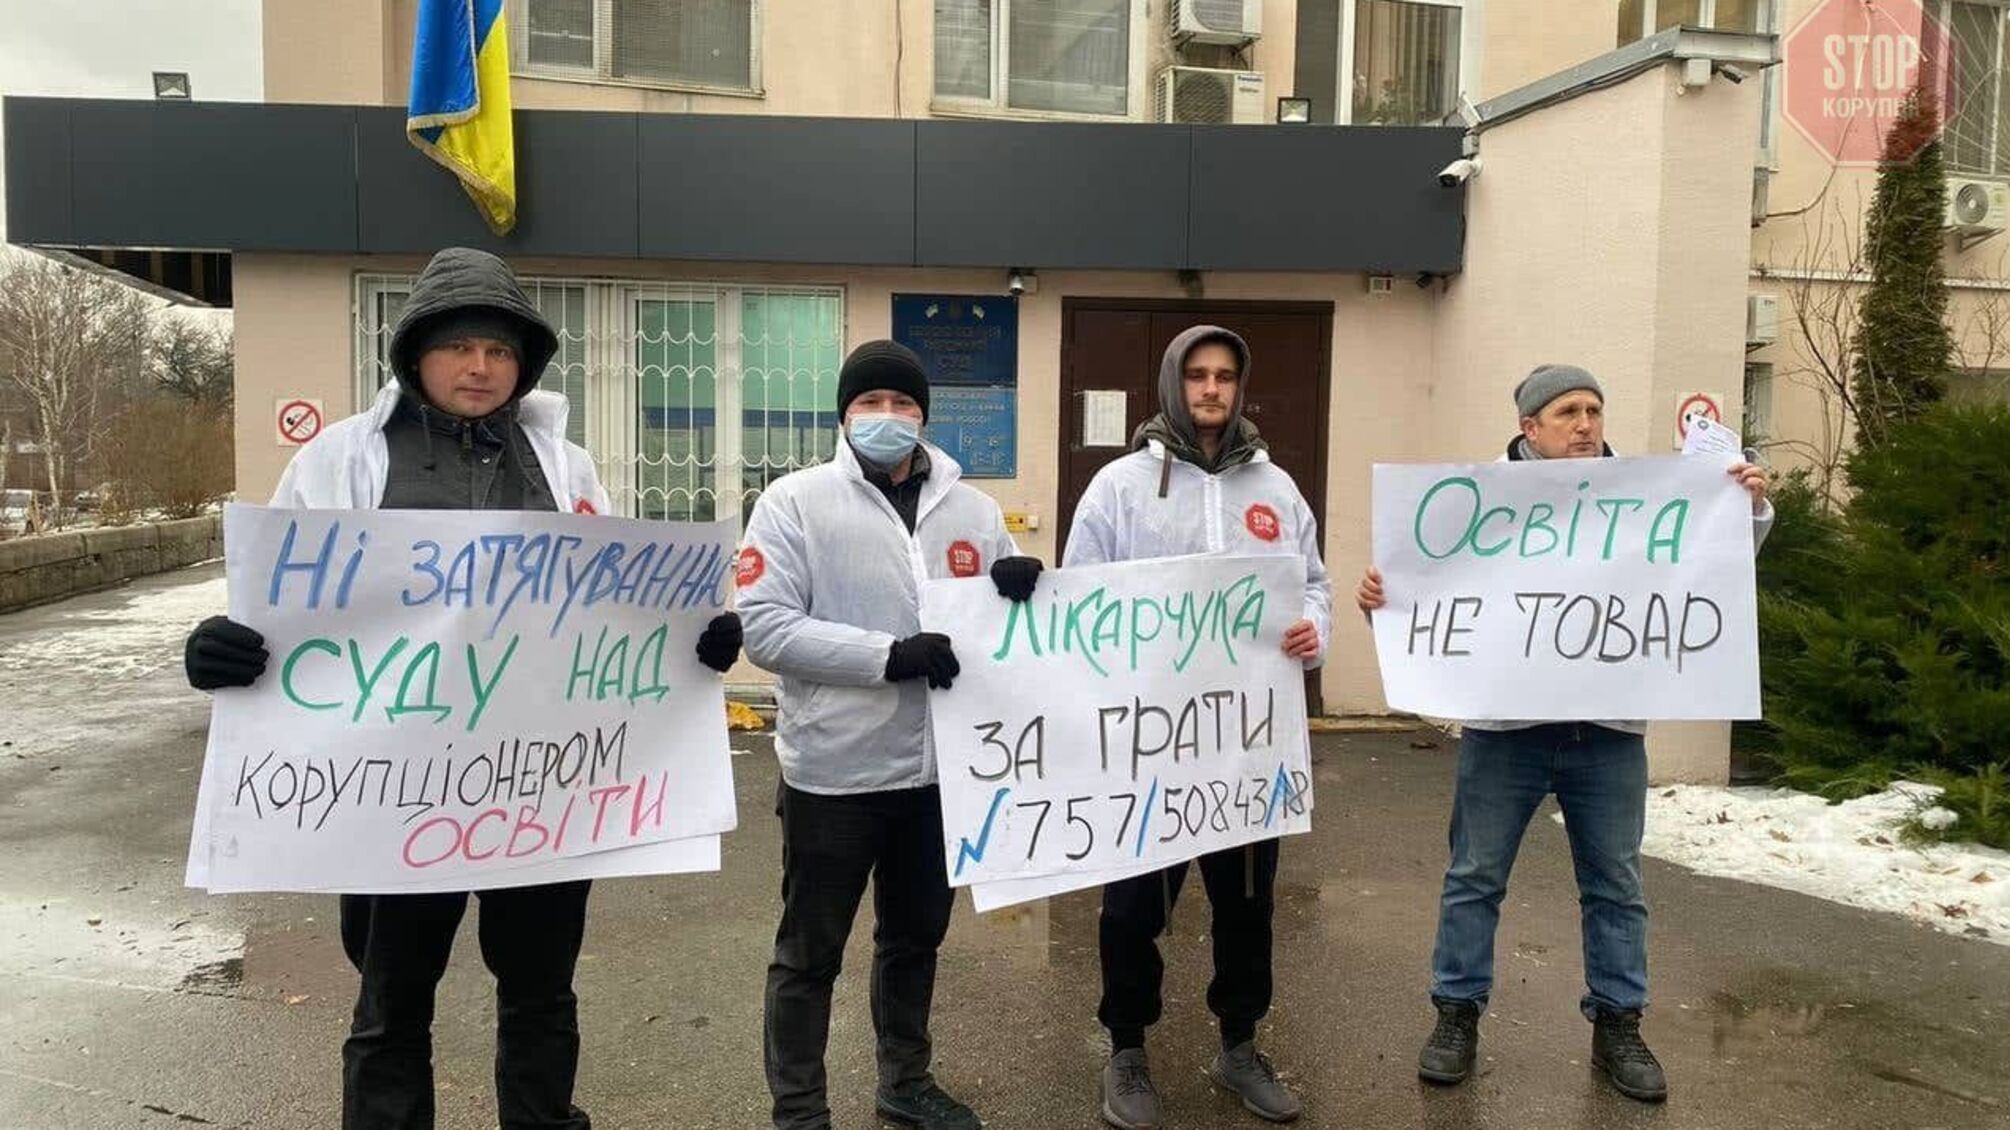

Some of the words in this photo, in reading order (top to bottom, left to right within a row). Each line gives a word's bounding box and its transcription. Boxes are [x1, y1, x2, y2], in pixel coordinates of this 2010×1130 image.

[268, 519, 367, 610] Ні
[280, 633, 520, 731] СУДУ
[564, 623, 670, 708] НАД
[1407, 597, 1483, 657] НЕ
[1515, 592, 1723, 674] ТОВАР
[968, 715, 1045, 782] ЗА
[1098, 687, 1274, 782] ГРАТИ
